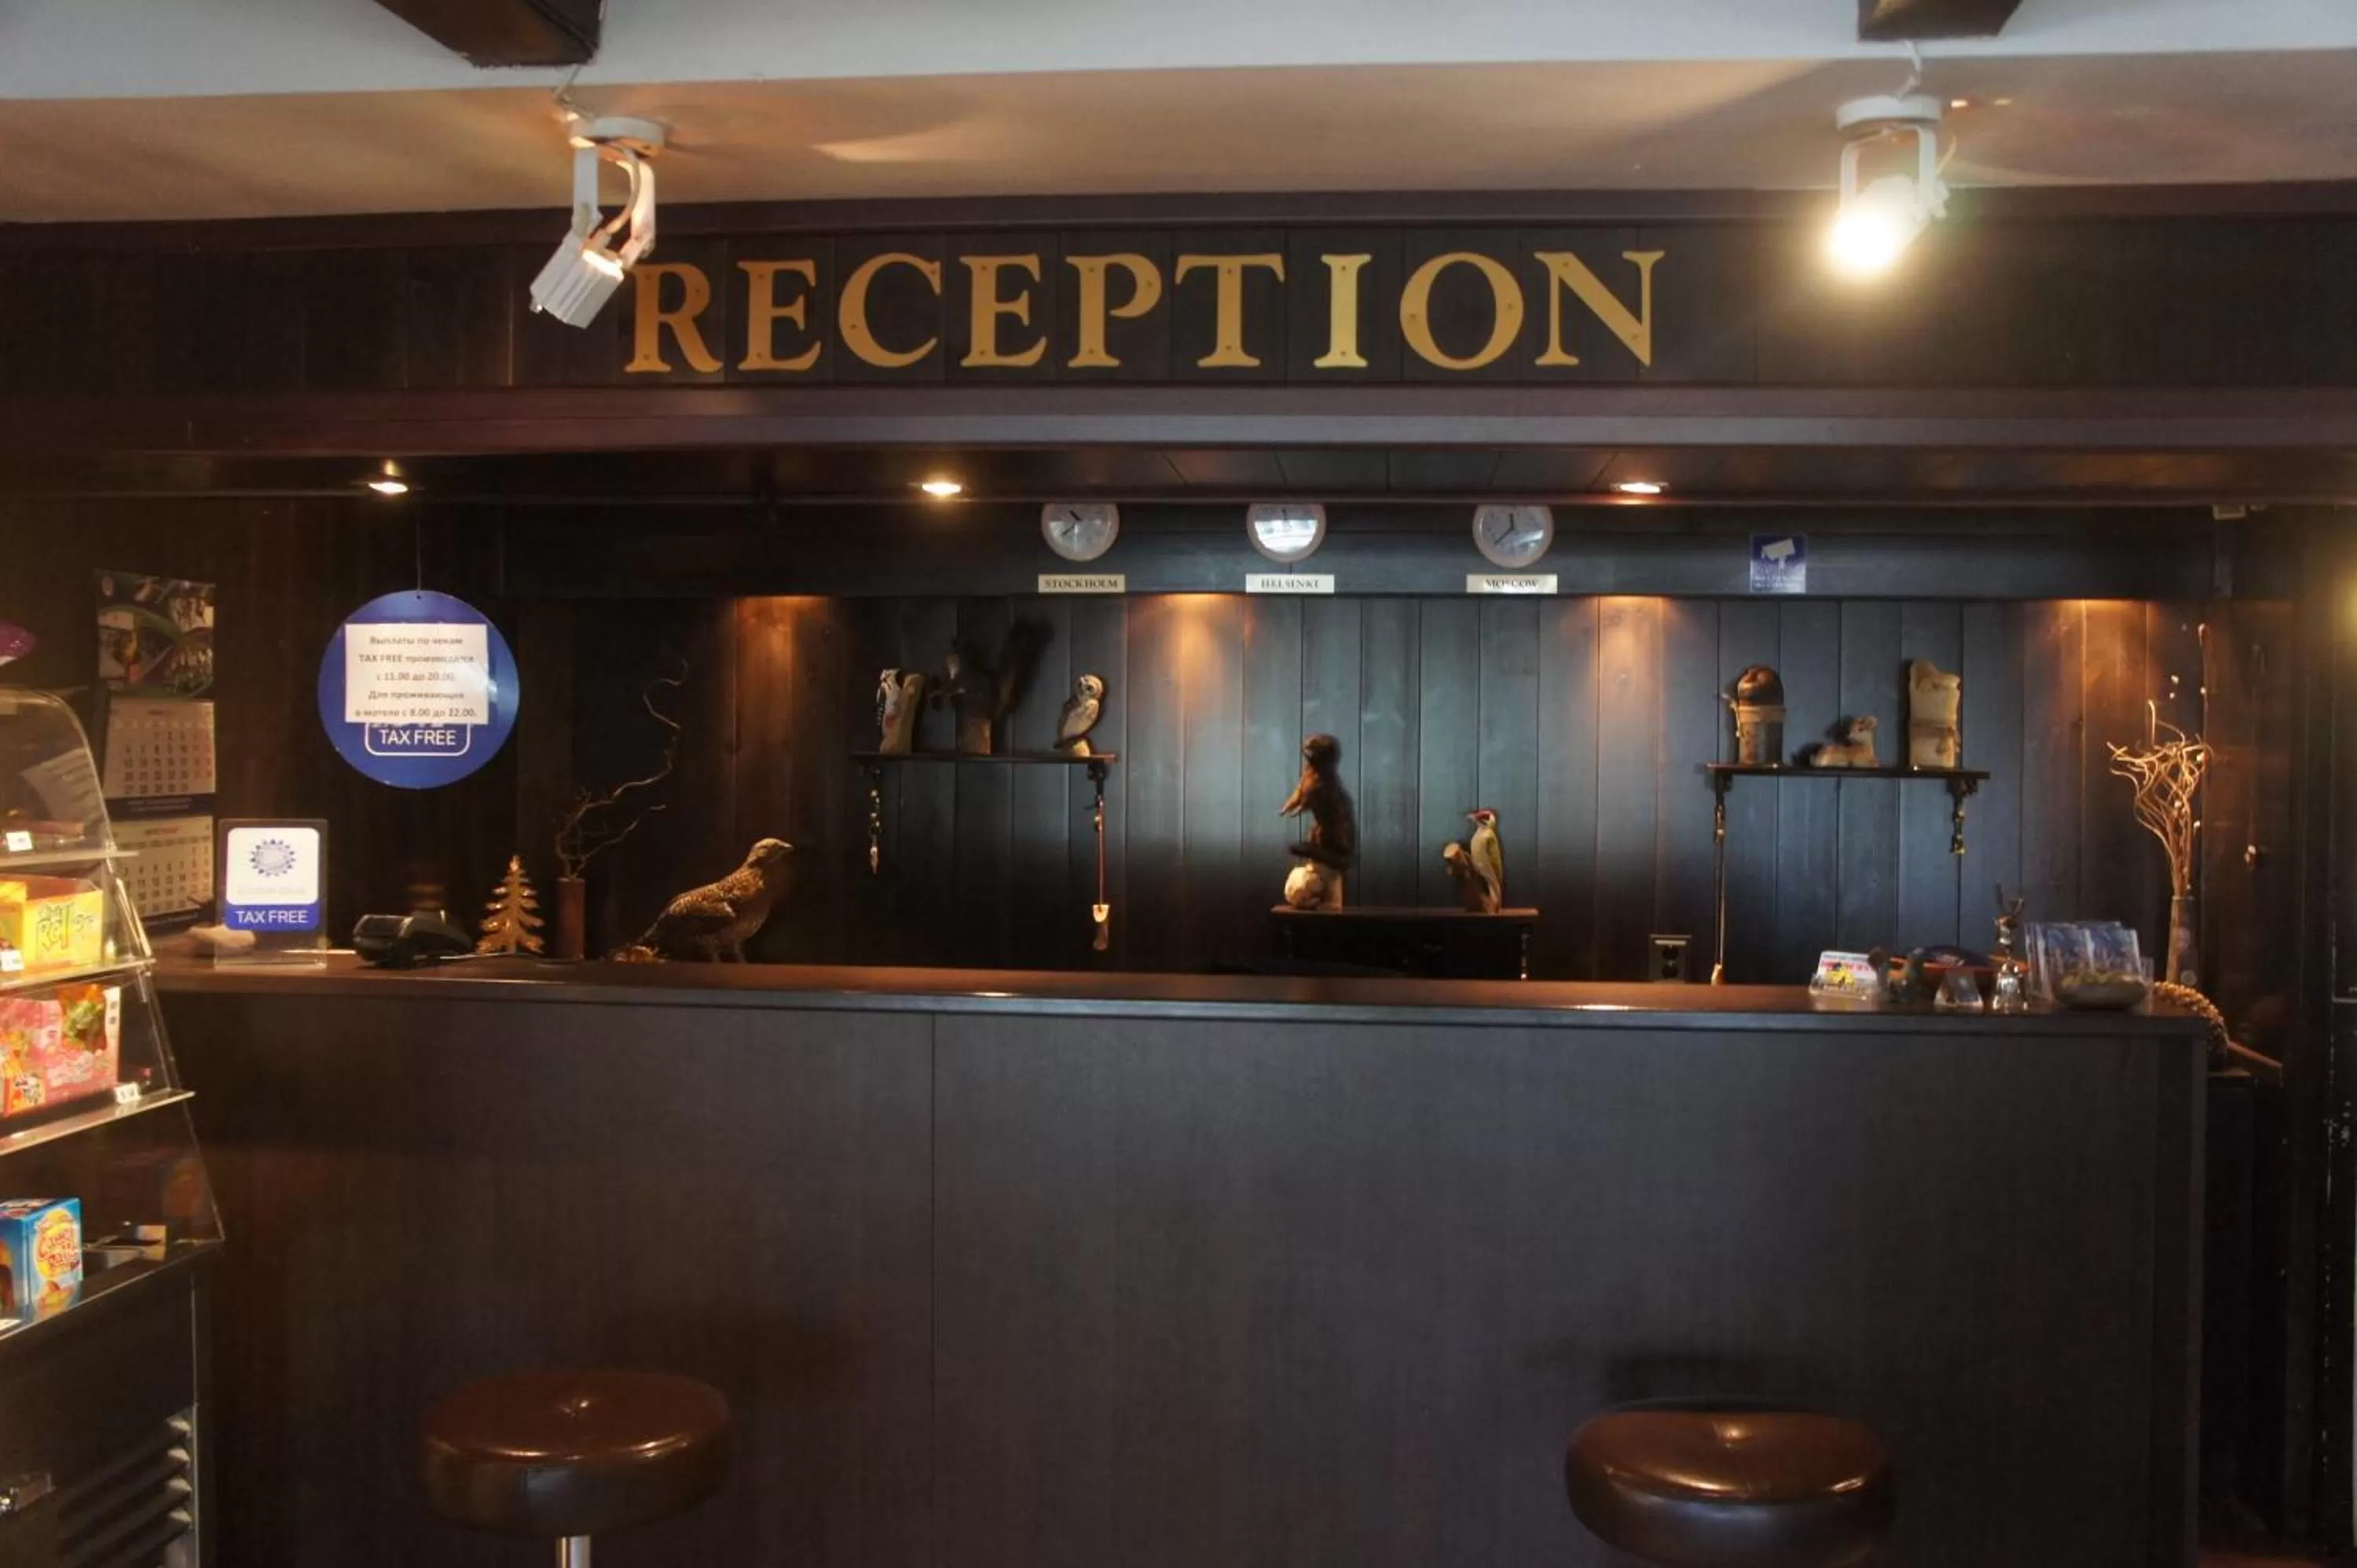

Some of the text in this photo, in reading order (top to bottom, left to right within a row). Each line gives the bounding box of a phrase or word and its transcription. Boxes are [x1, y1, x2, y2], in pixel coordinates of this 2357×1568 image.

[625, 249, 1666, 373] RECEPTION
[1044, 578, 1118, 588] STOCKHOLM
[1261, 578, 1320, 588] HELSINKI
[379, 729, 456, 746] TAX FREE
[234, 910, 310, 924] TAX FREE
